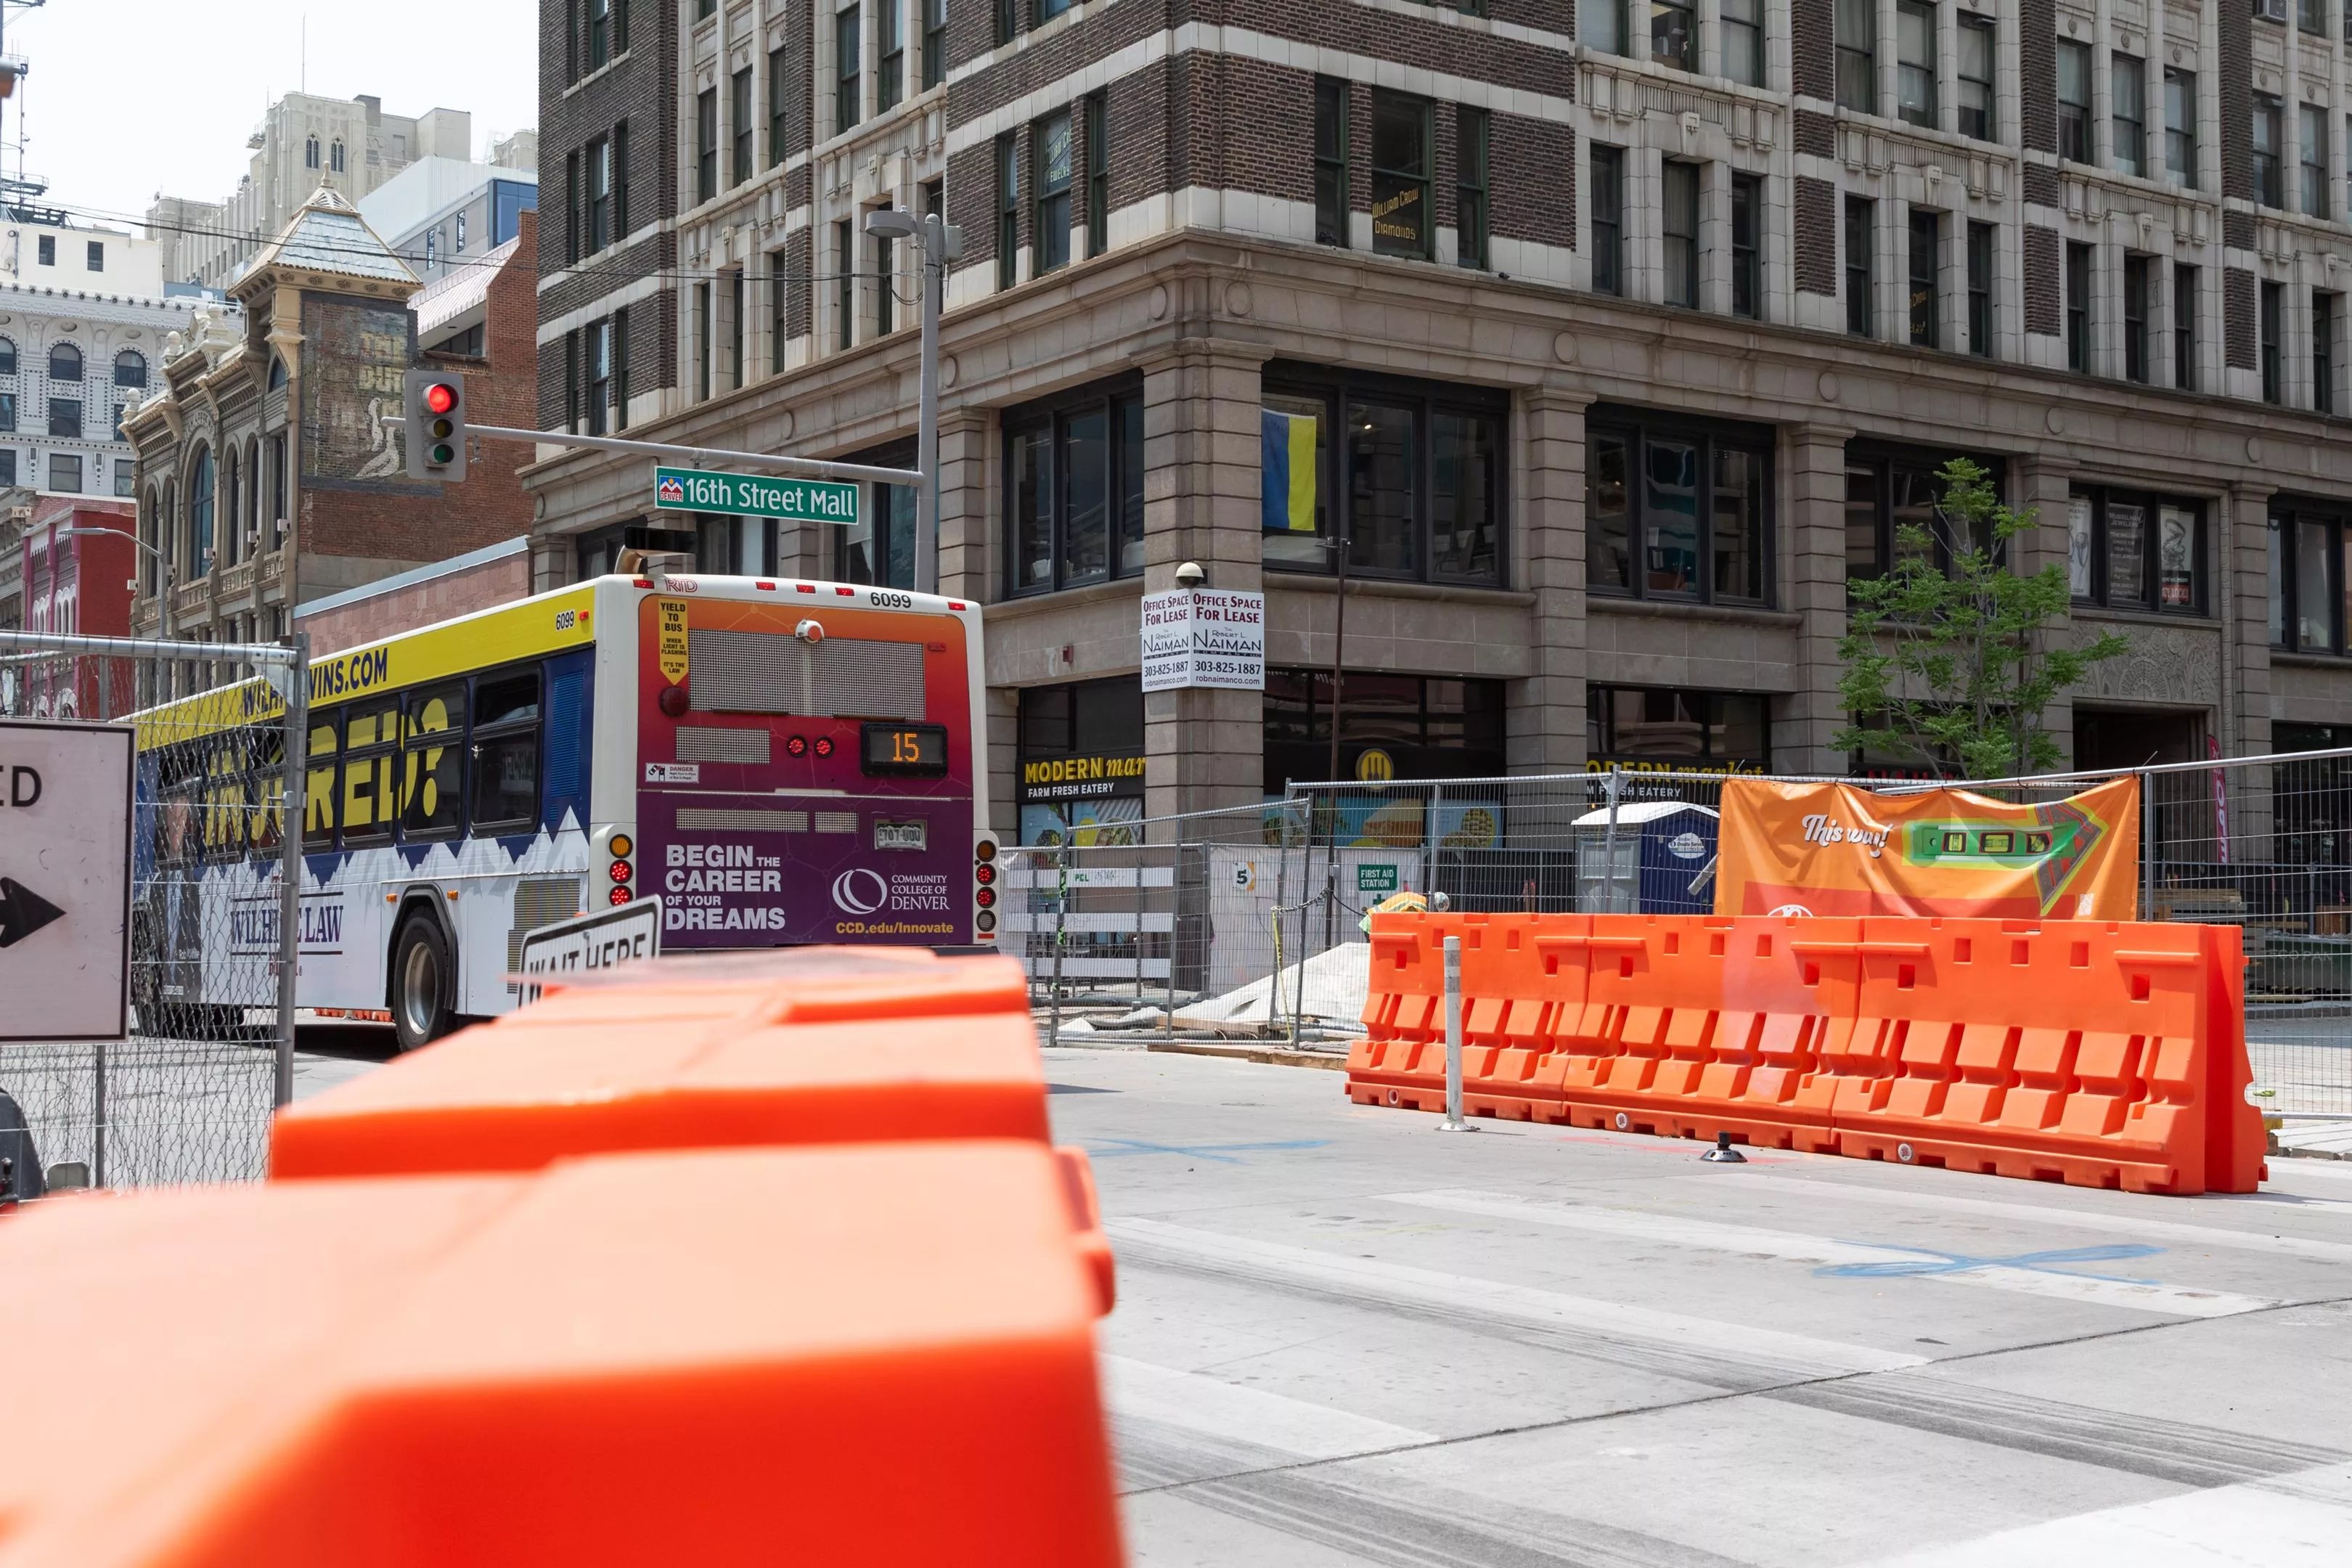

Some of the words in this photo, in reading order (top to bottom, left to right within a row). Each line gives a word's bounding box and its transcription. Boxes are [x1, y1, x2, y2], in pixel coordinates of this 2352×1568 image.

[1372, 197, 1399, 219] WILLIAM
[1400, 187, 1418, 206] CROW
[1375, 220, 1416, 240] DIAMONDS
[660, 492, 683, 502] DENVER
[685, 478, 732, 506] 16th
[738, 482, 804, 513] Street
[810, 489, 854, 517] Mall
[665, 578, 698, 593] RTD
[660, 602, 686, 612] YIELD
[870, 592, 912, 608] 6099
[1143, 599, 1166, 613] OFFICE
[1167, 595, 1189, 608] SPACE
[1193, 593, 1228, 607] OFFICE
[1230, 596, 1262, 609] SPACE
[555, 609, 576, 632] 6099
[667, 613, 679, 622] TO
[1146, 613, 1161, 626] FOR
[1164, 608, 1188, 623] LEASE
[1196, 607, 1220, 621] FOR
[1224, 608, 1259, 624] LEASE
[664, 623, 682, 632] BUS
[1143, 634, 1189, 653] NAIMAN
[1193, 629, 1262, 652] NAIMAN
[1144, 661, 1189, 677] 303-825-1887
[1194, 661, 1262, 675] 303-825-1887
[1144, 676, 1188, 687] robnaimanco.com
[1196, 675, 1260, 685] robnaimanco.com
[892, 732, 920, 761] 15
[1024, 757, 1104, 784] MODERN
[1106, 756, 1147, 777] mar
[1028, 787, 1050, 798] FARM
[1053, 785, 1079, 796] FRESH
[1081, 783, 1114, 794] EATERY
[1638, 787, 1682, 798] EATERY
[1802, 814, 1844, 847] This
[666, 844, 754, 867] BEGIN
[756, 856, 780, 867] THE
[665, 869, 782, 893] CAREER
[891, 874, 947, 883] COMMUNITY
[1236, 869, 1247, 884] 5
[1360, 869, 1380, 878] FIRST
[1381, 869, 1394, 878] AID
[891, 885, 933, 894] COLLEGE
[1360, 878, 1389, 888] STATION
[665, 895, 683, 906] OF
[686, 895, 722, 906] YOUR
[891, 896, 951, 910] DENVER
[304, 905, 343, 943] LAW
[665, 907, 786, 930] DREAMS
[836, 921, 954, 934] CCD.edu/Innovate
